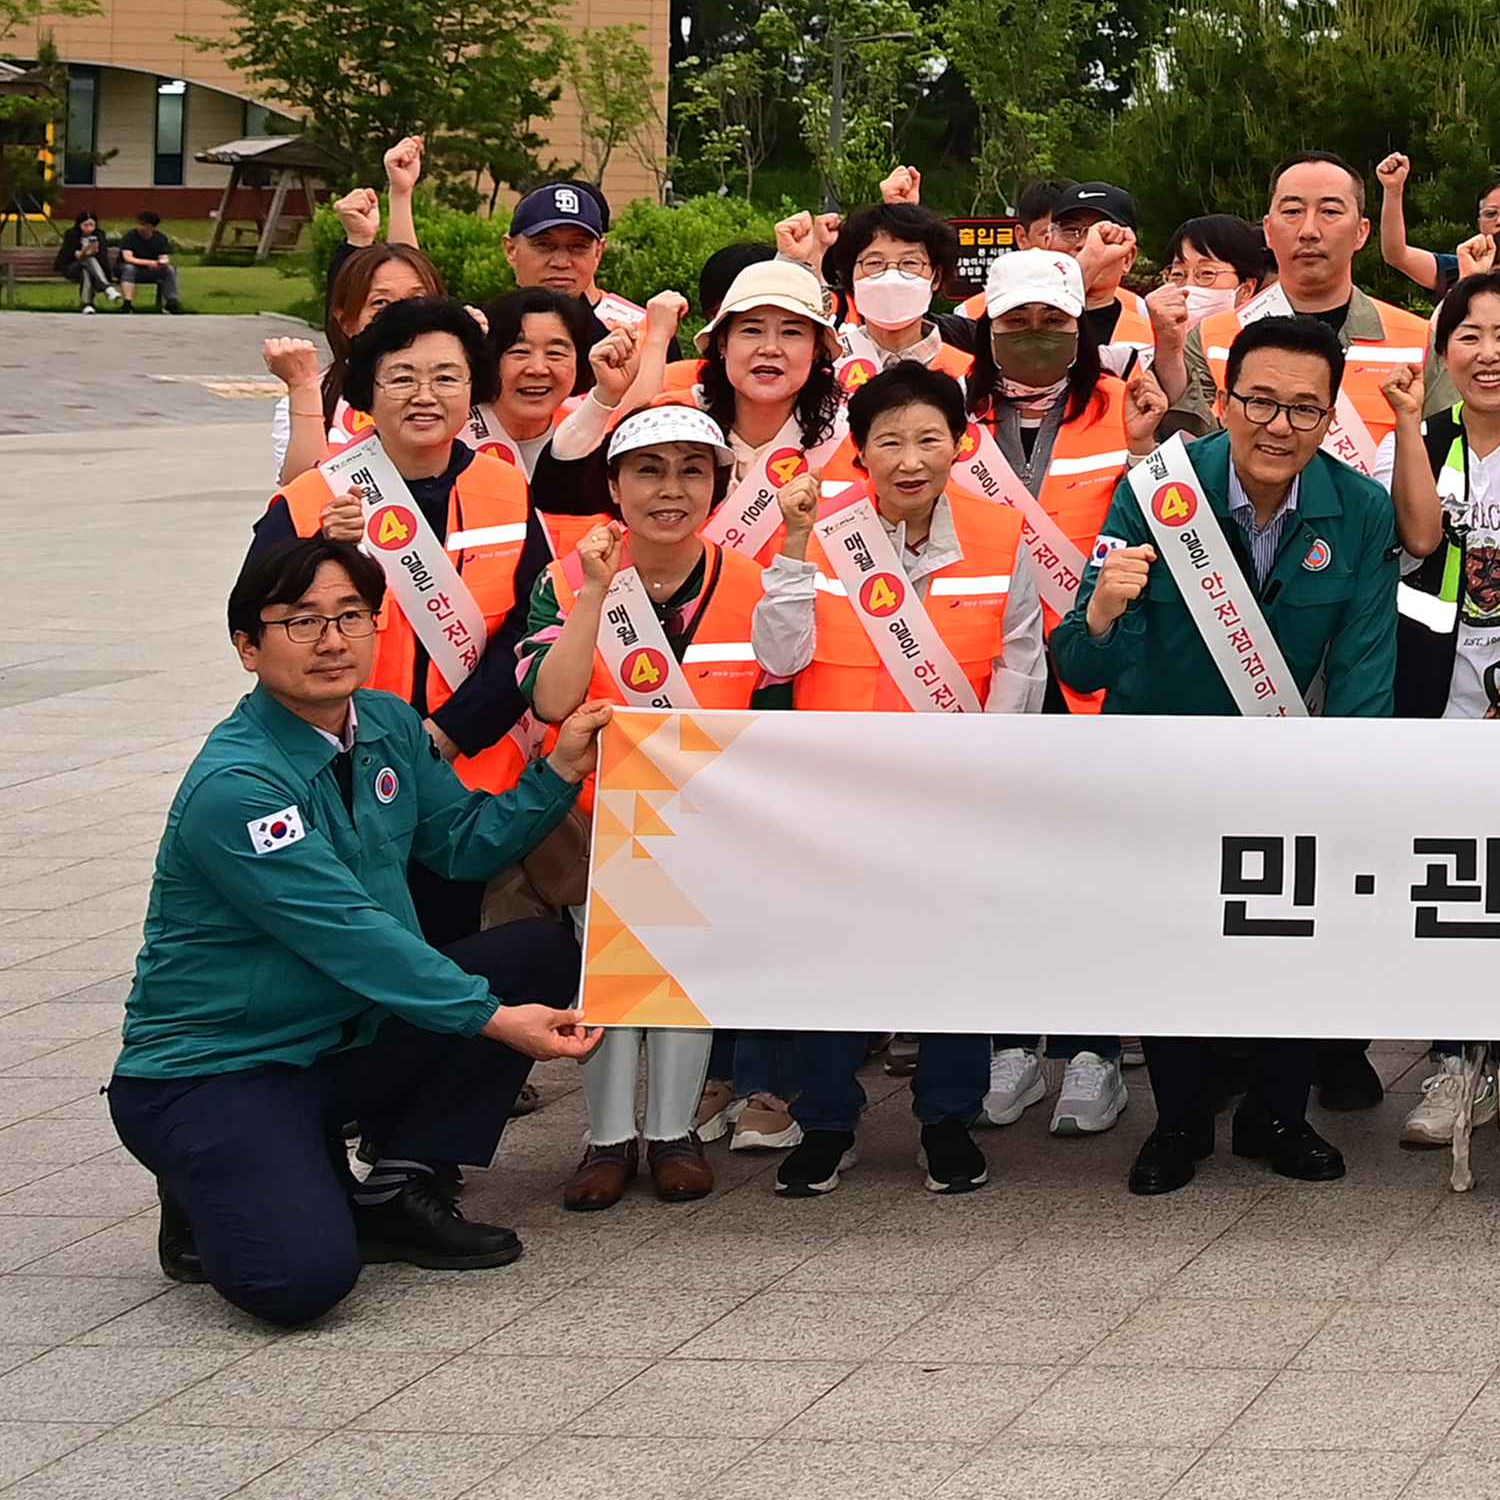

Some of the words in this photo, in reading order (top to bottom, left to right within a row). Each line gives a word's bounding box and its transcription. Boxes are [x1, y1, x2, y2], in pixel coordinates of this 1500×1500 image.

[959, 228, 1013, 245] 출입금
[351, 467, 385, 506] 매월
[843, 531, 876, 572] 매월
[607, 603, 639, 646] 매월
[1201, 571, 1278, 701] 안전점검의
